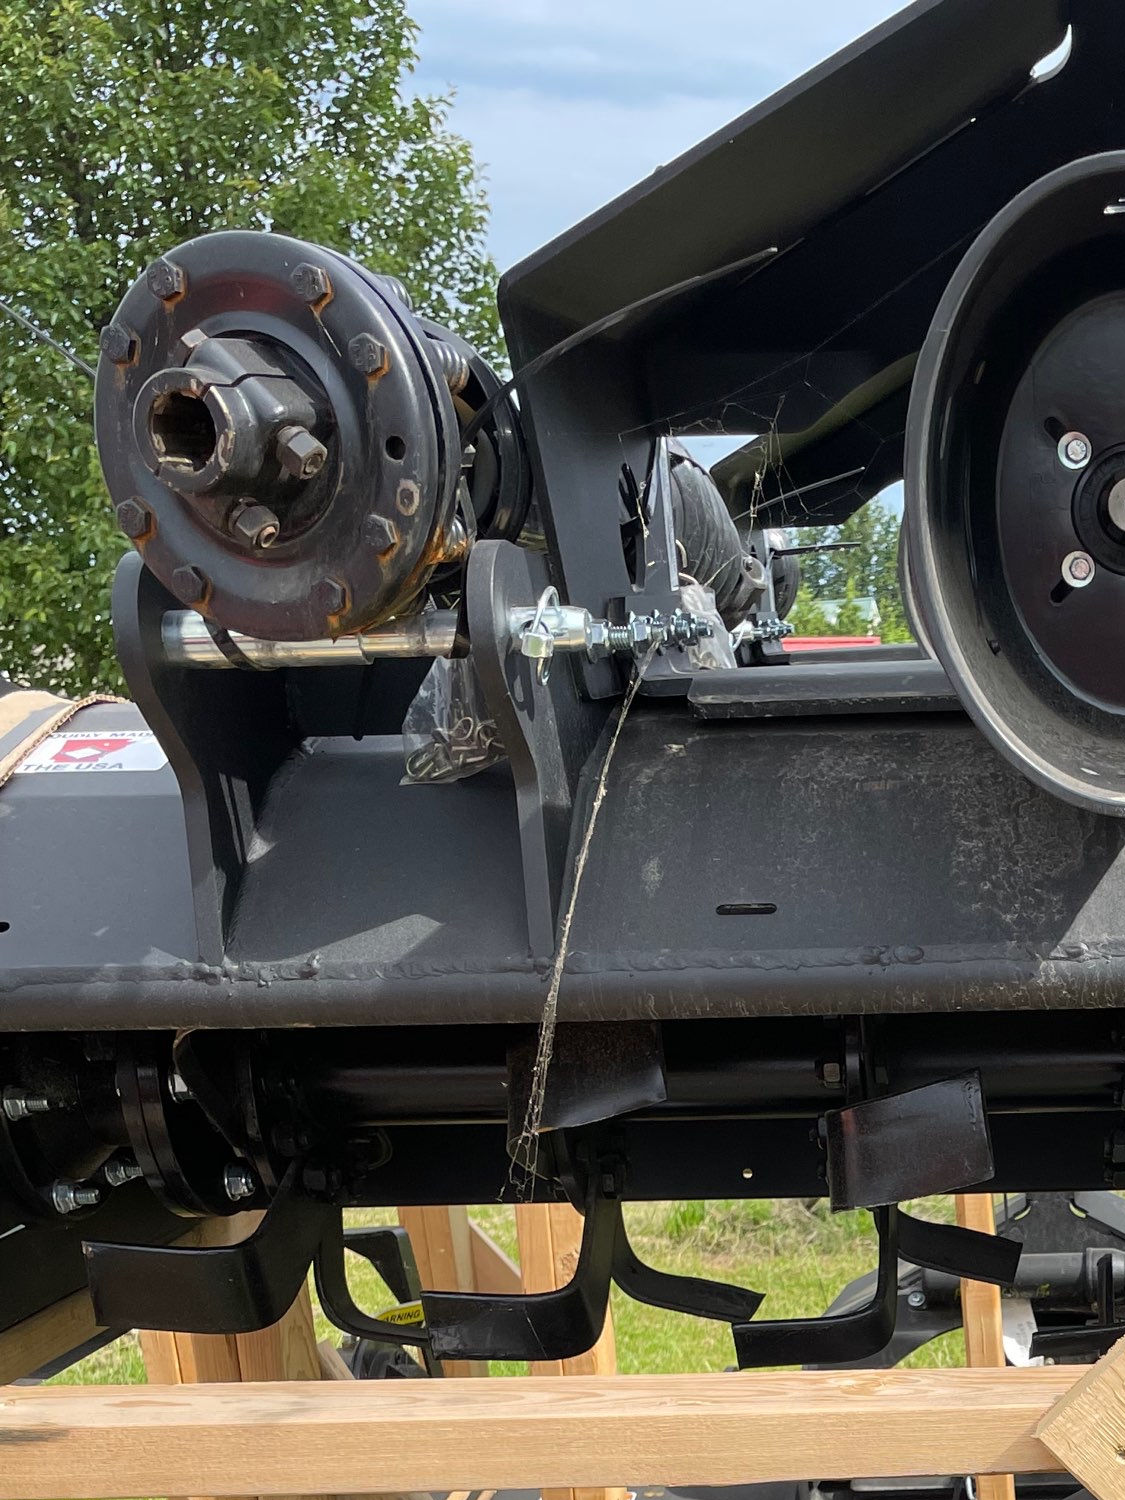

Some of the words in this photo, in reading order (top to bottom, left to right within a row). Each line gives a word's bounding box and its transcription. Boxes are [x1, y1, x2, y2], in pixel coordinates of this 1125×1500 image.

[23, 763, 66, 771] THE
[75, 762, 124, 770] USA
[384, 1310, 421, 1322] ARNING
